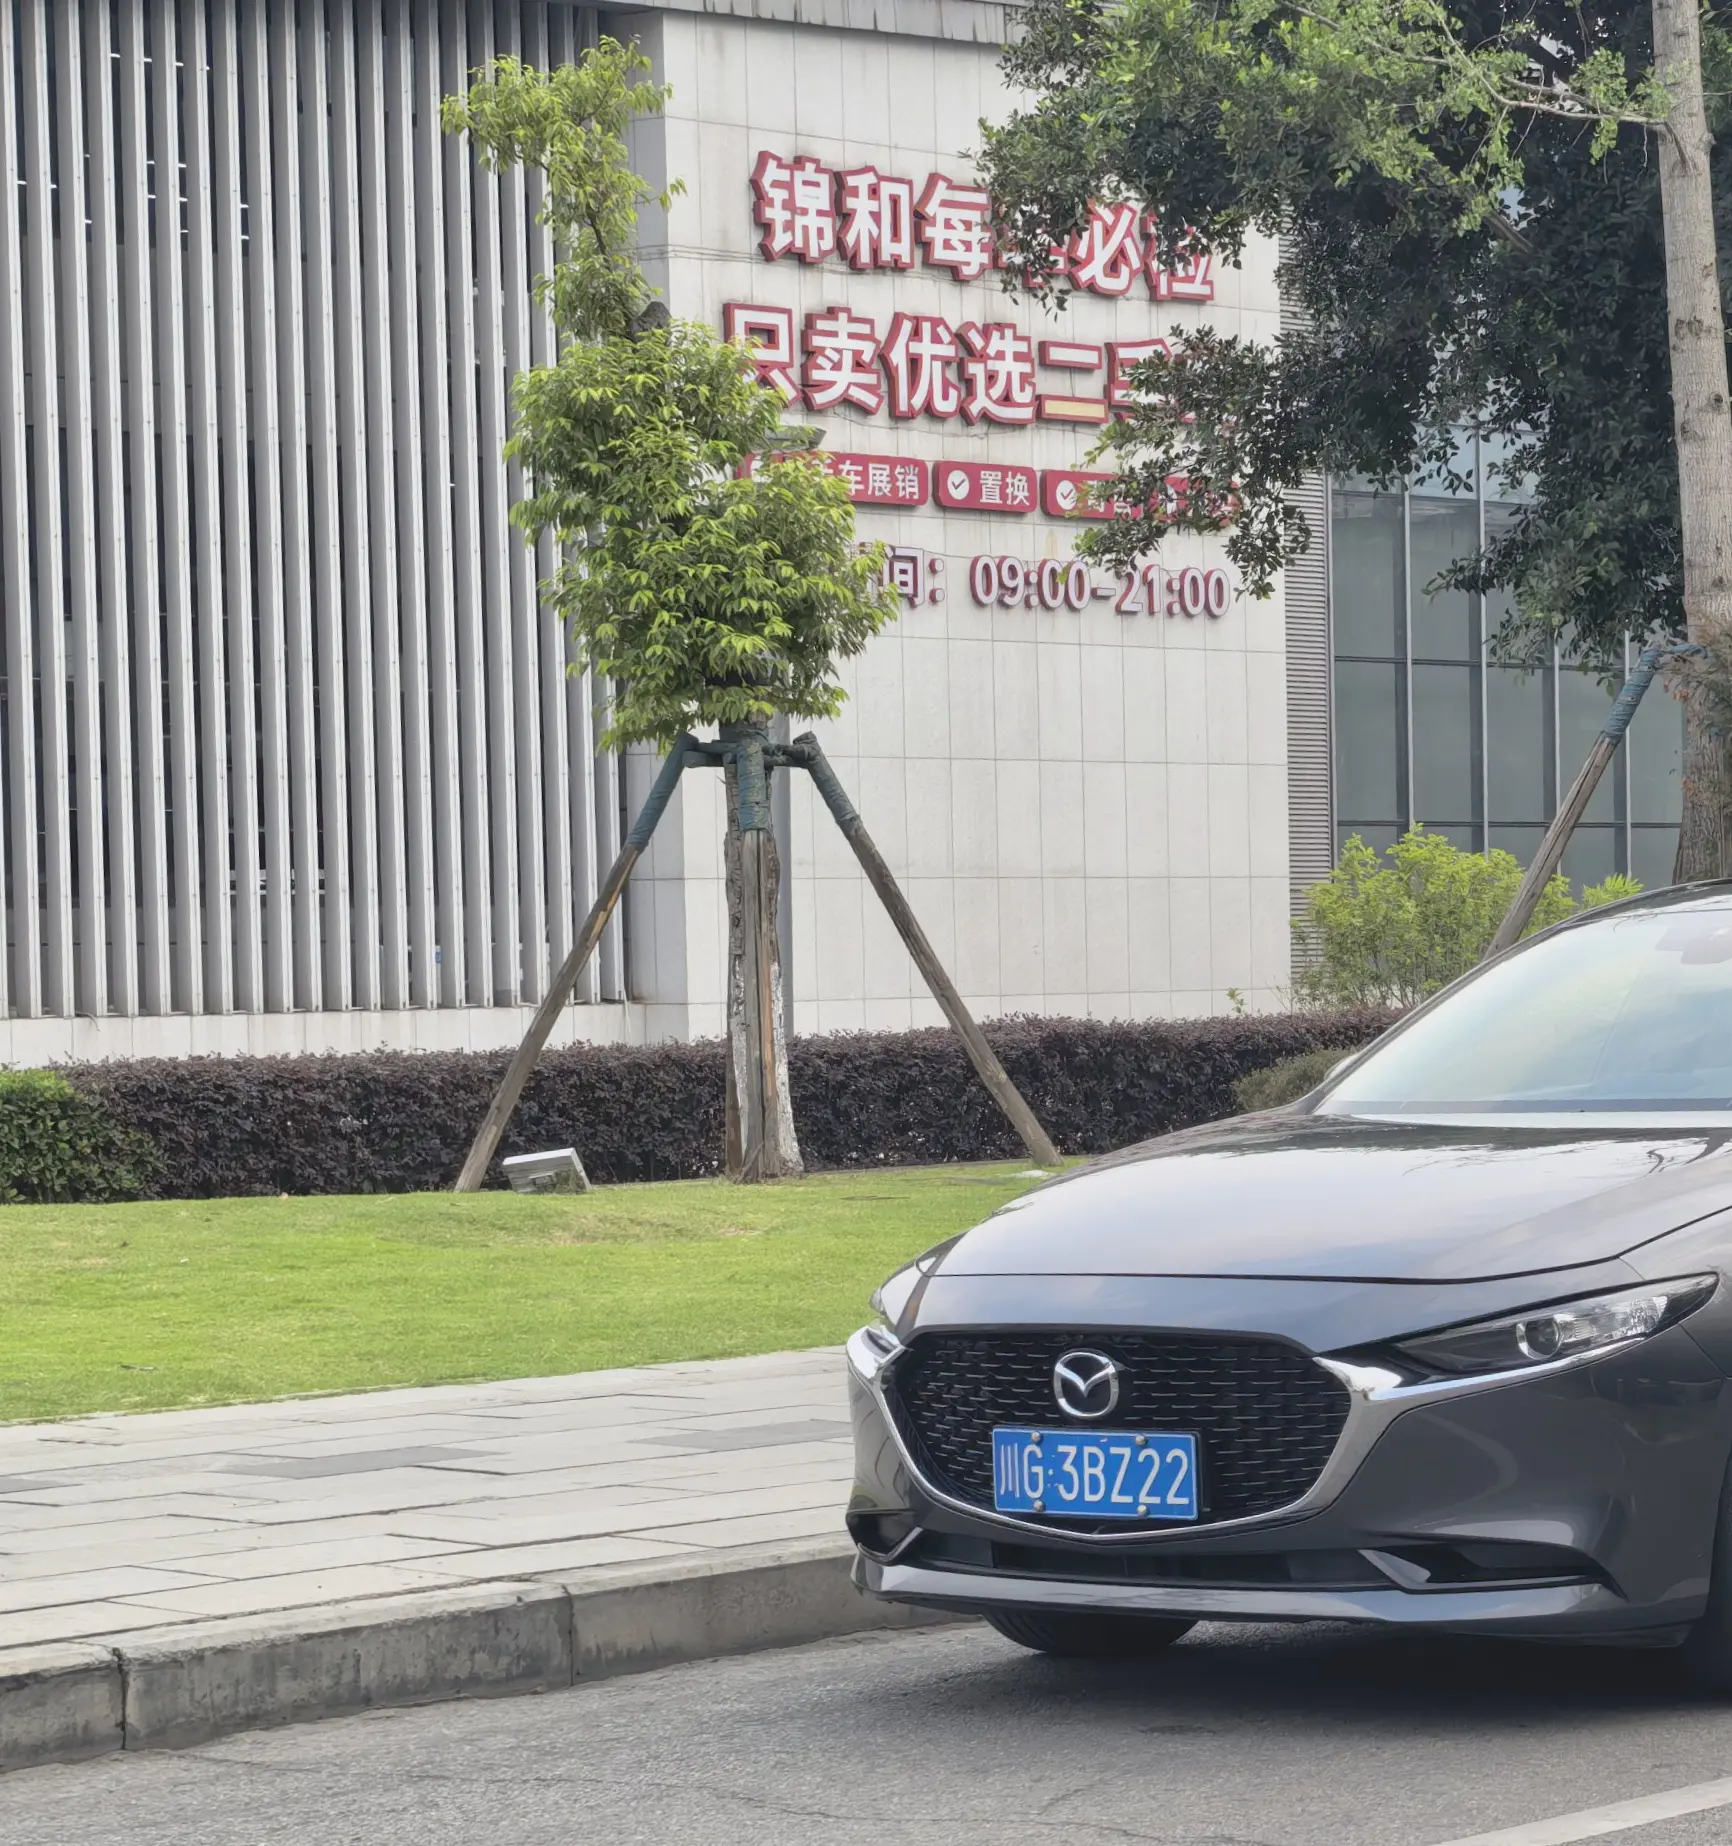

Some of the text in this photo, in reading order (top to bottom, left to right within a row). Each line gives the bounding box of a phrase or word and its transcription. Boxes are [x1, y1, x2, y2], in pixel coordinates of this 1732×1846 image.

[750, 150, 1215, 301] 锦和每必
[785, 455, 920, 502] 车展销
[978, 470, 1031, 506] 置换
